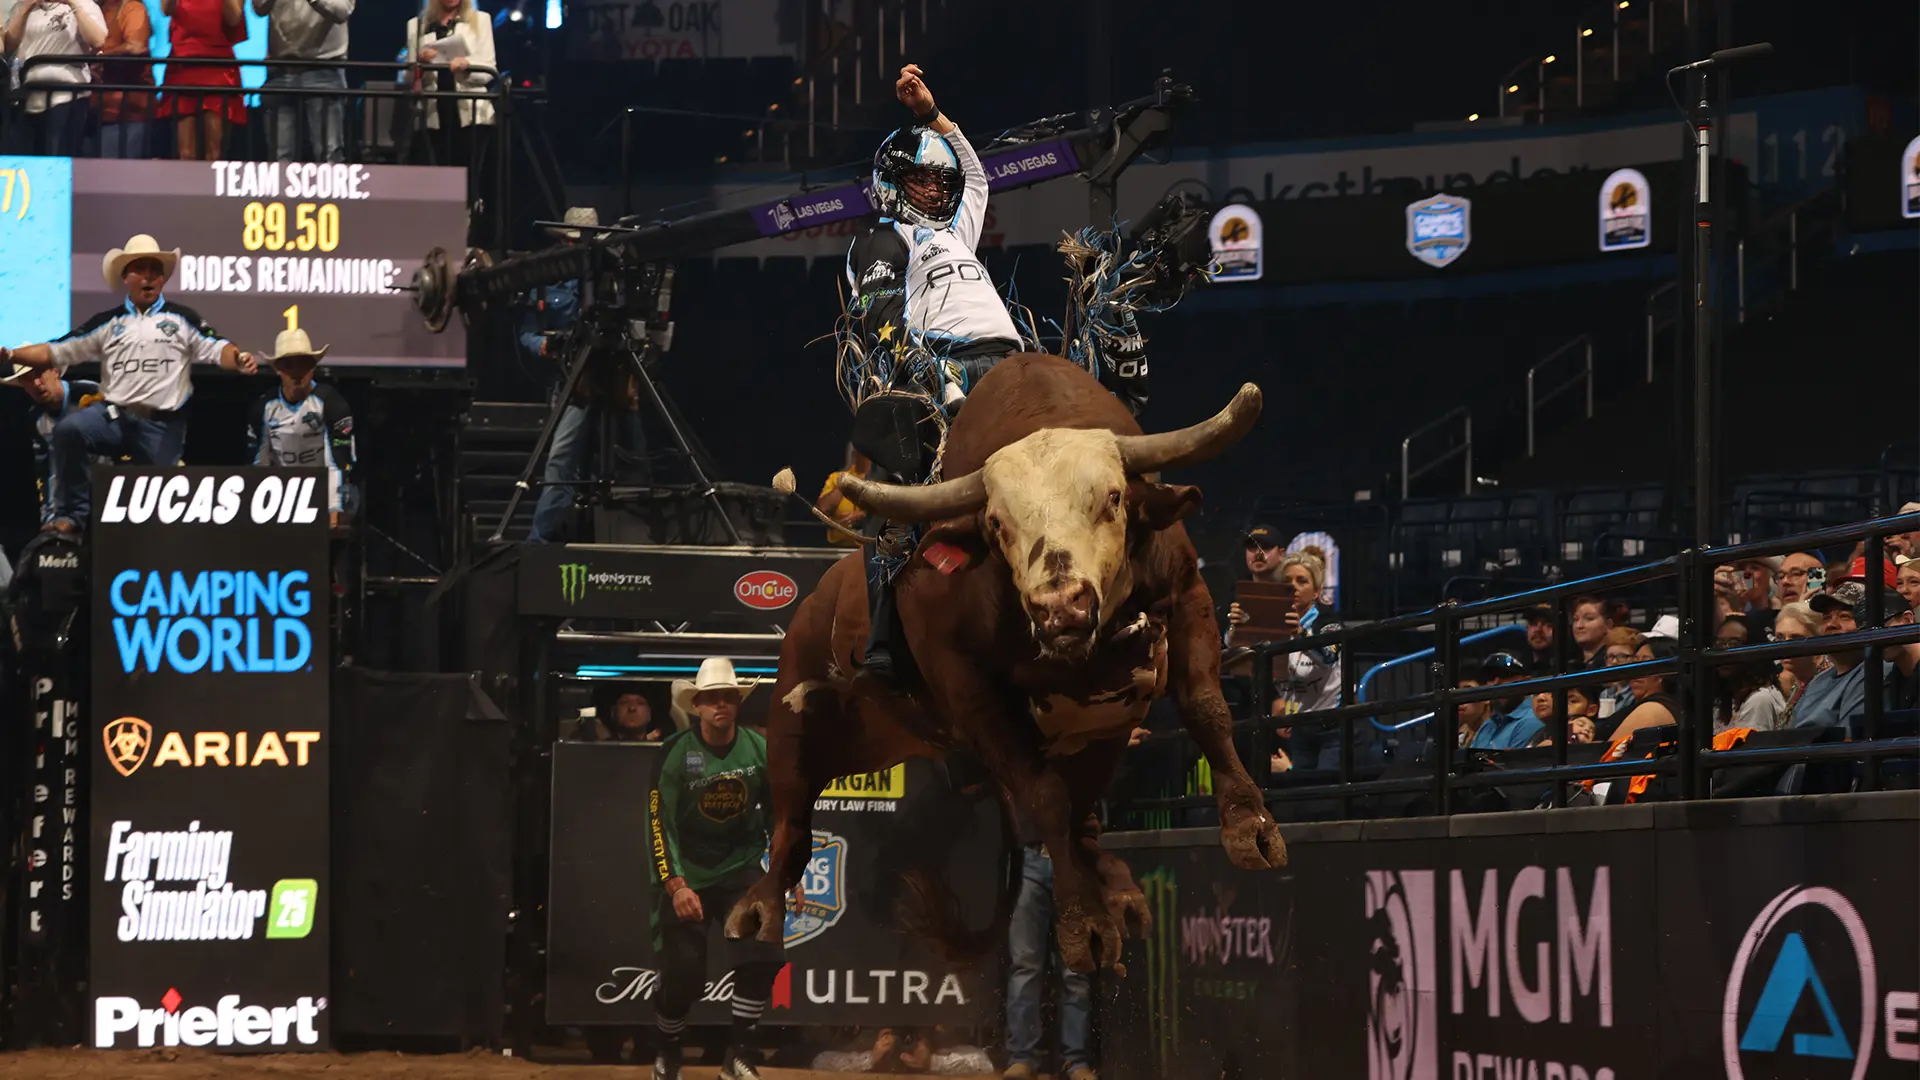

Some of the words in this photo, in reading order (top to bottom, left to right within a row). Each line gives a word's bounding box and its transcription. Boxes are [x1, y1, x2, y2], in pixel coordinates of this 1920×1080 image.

[669, 2, 721, 32] OAK
[624, 39, 698, 60] YOTA
[995, 164, 1018, 178] LAS
[1017, 152, 1058, 173] VEGAS
[1764, 124, 1847, 183] 112
[211, 161, 279, 197] TEAM
[285, 162, 371, 200] SCORE:
[242, 201, 340, 252] 89.50
[794, 205, 814, 219] LAS
[812, 198, 844, 215] VEGAS
[180, 256, 252, 292] RIDES
[257, 257, 402, 294] REMAINING:
[282, 304, 299, 330] 1
[100, 474, 246, 525] LUCAS
[250, 474, 319, 525] OIL
[38, 552, 79, 569] Merit
[588, 571, 652, 586] MONSTER
[109, 569, 312, 617] CAMPING
[738, 580, 793, 600] OnCue
[111, 616, 312, 674] WORLD
[152, 731, 321, 767] ARIAT
[814, 800, 838, 811] URY
[840, 800, 865, 812] LAW
[866, 801, 897, 813] FIRM
[104, 820, 233, 890] Farming
[656, 858, 671, 881] TEA
[117, 880, 267, 942] Simulator
[276, 889, 309, 928] 25
[1180, 905, 1275, 967] MONSTER
[1449, 865, 1614, 1028] MGM
[805, 969, 966, 1005] ULTRA
[95, 986, 320, 1048] Priefert
